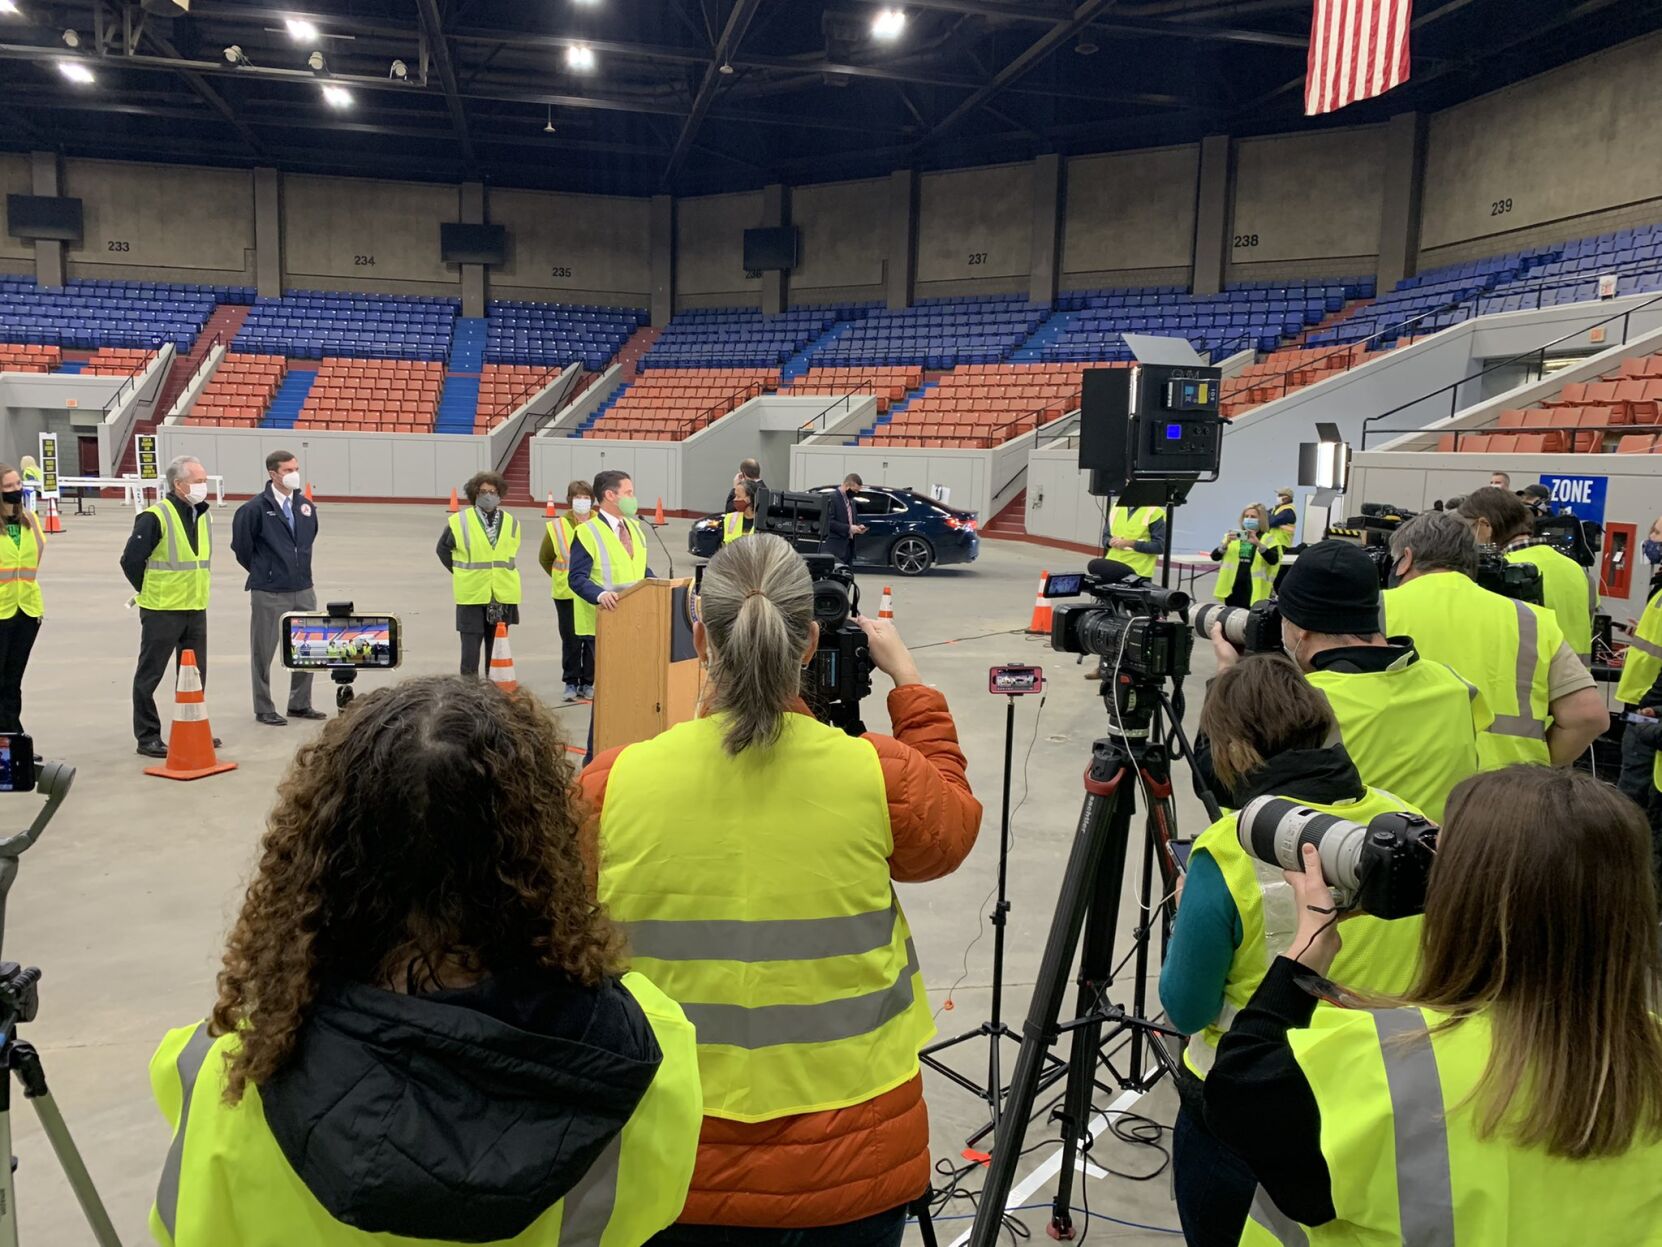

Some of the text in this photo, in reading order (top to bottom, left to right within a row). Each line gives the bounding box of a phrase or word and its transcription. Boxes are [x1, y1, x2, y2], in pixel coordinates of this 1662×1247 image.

[1490, 197, 1513, 217] 239
[107, 240, 130, 252] 233
[1233, 234, 1260, 249] 238
[354, 255, 376, 267] 234
[967, 252, 988, 265] 237
[551, 266, 572, 278] 235
[1550, 478, 1594, 504] ZONE
